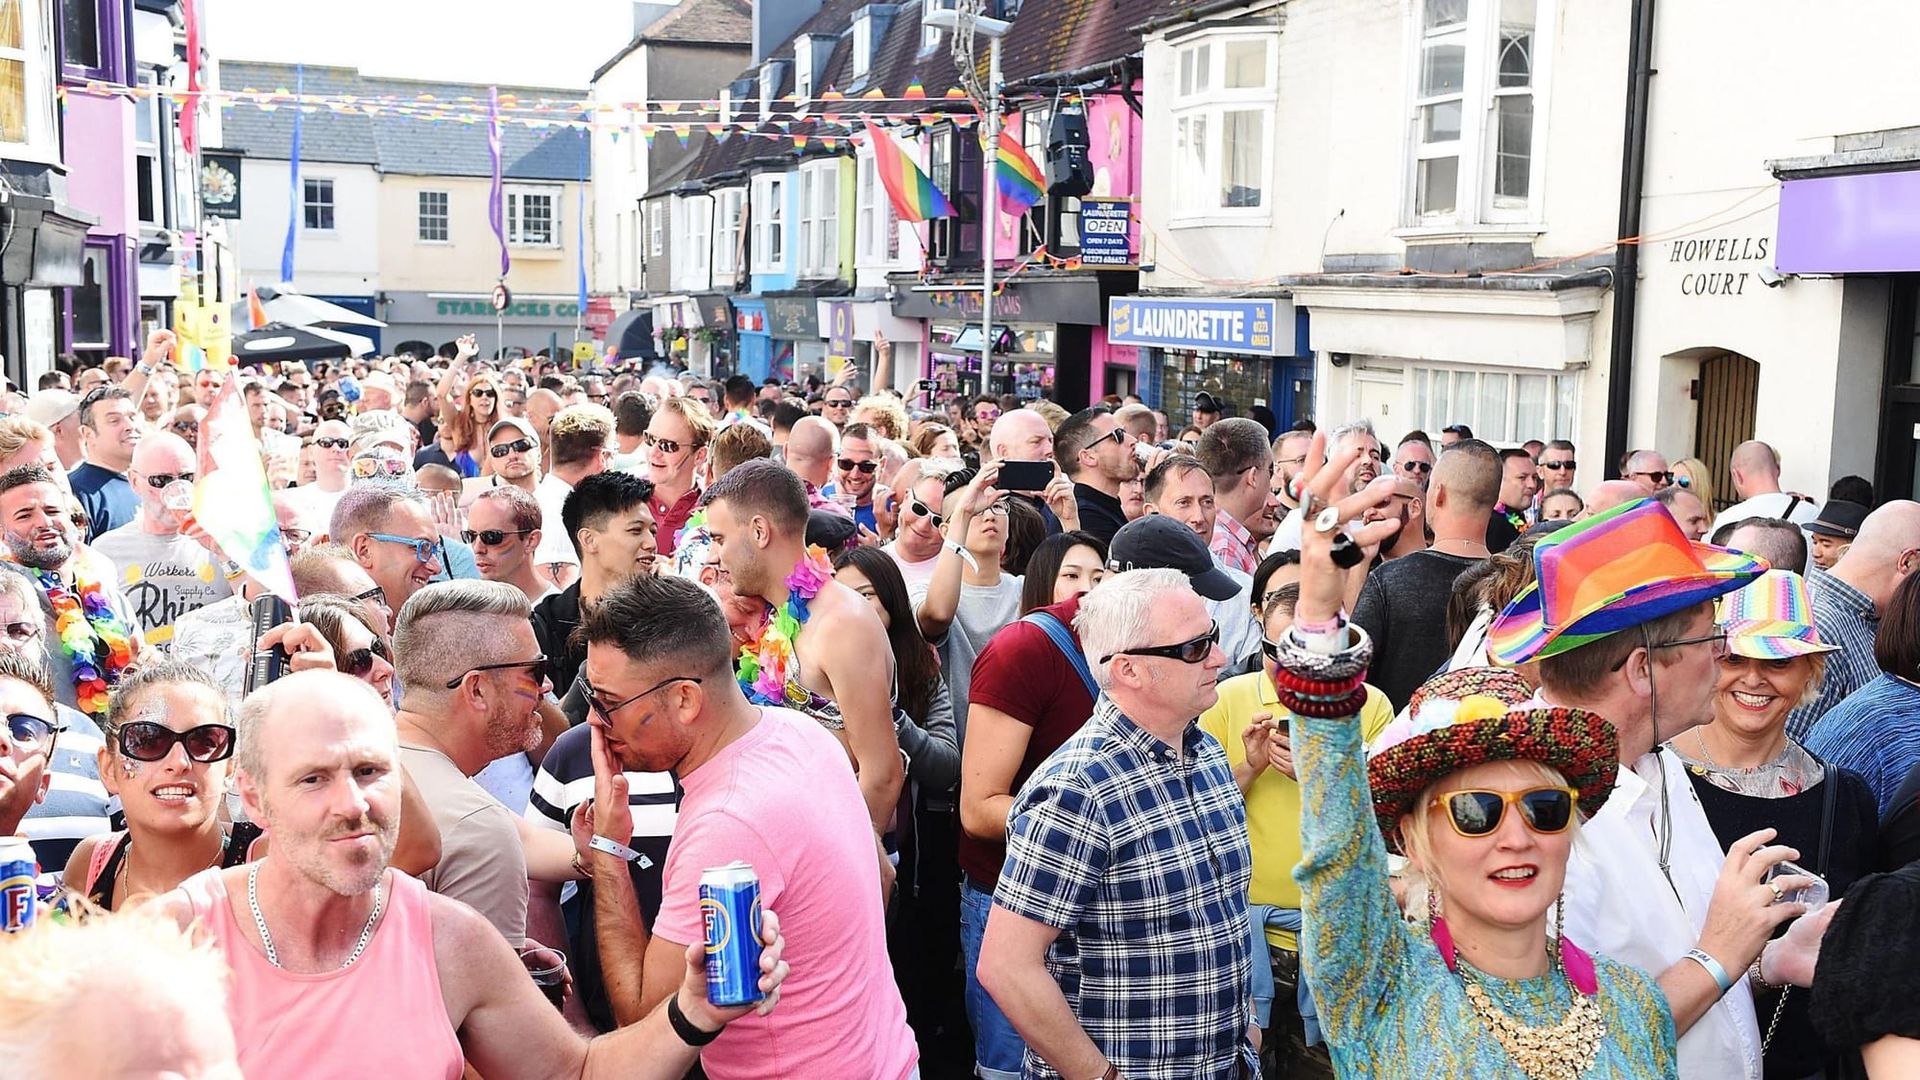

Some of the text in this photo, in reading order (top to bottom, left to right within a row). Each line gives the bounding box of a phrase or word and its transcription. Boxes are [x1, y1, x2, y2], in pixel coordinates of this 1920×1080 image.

[1088, 220, 1124, 231] OPEN
[1670, 238, 1769, 261] HOWELLS
[1681, 272, 1750, 295] COURT
[1133, 308, 1244, 342] LAUNDRETTE
[144, 562, 196, 578] Workers
[174, 584, 203, 599] Supply
[5, 886, 31, 931] F
